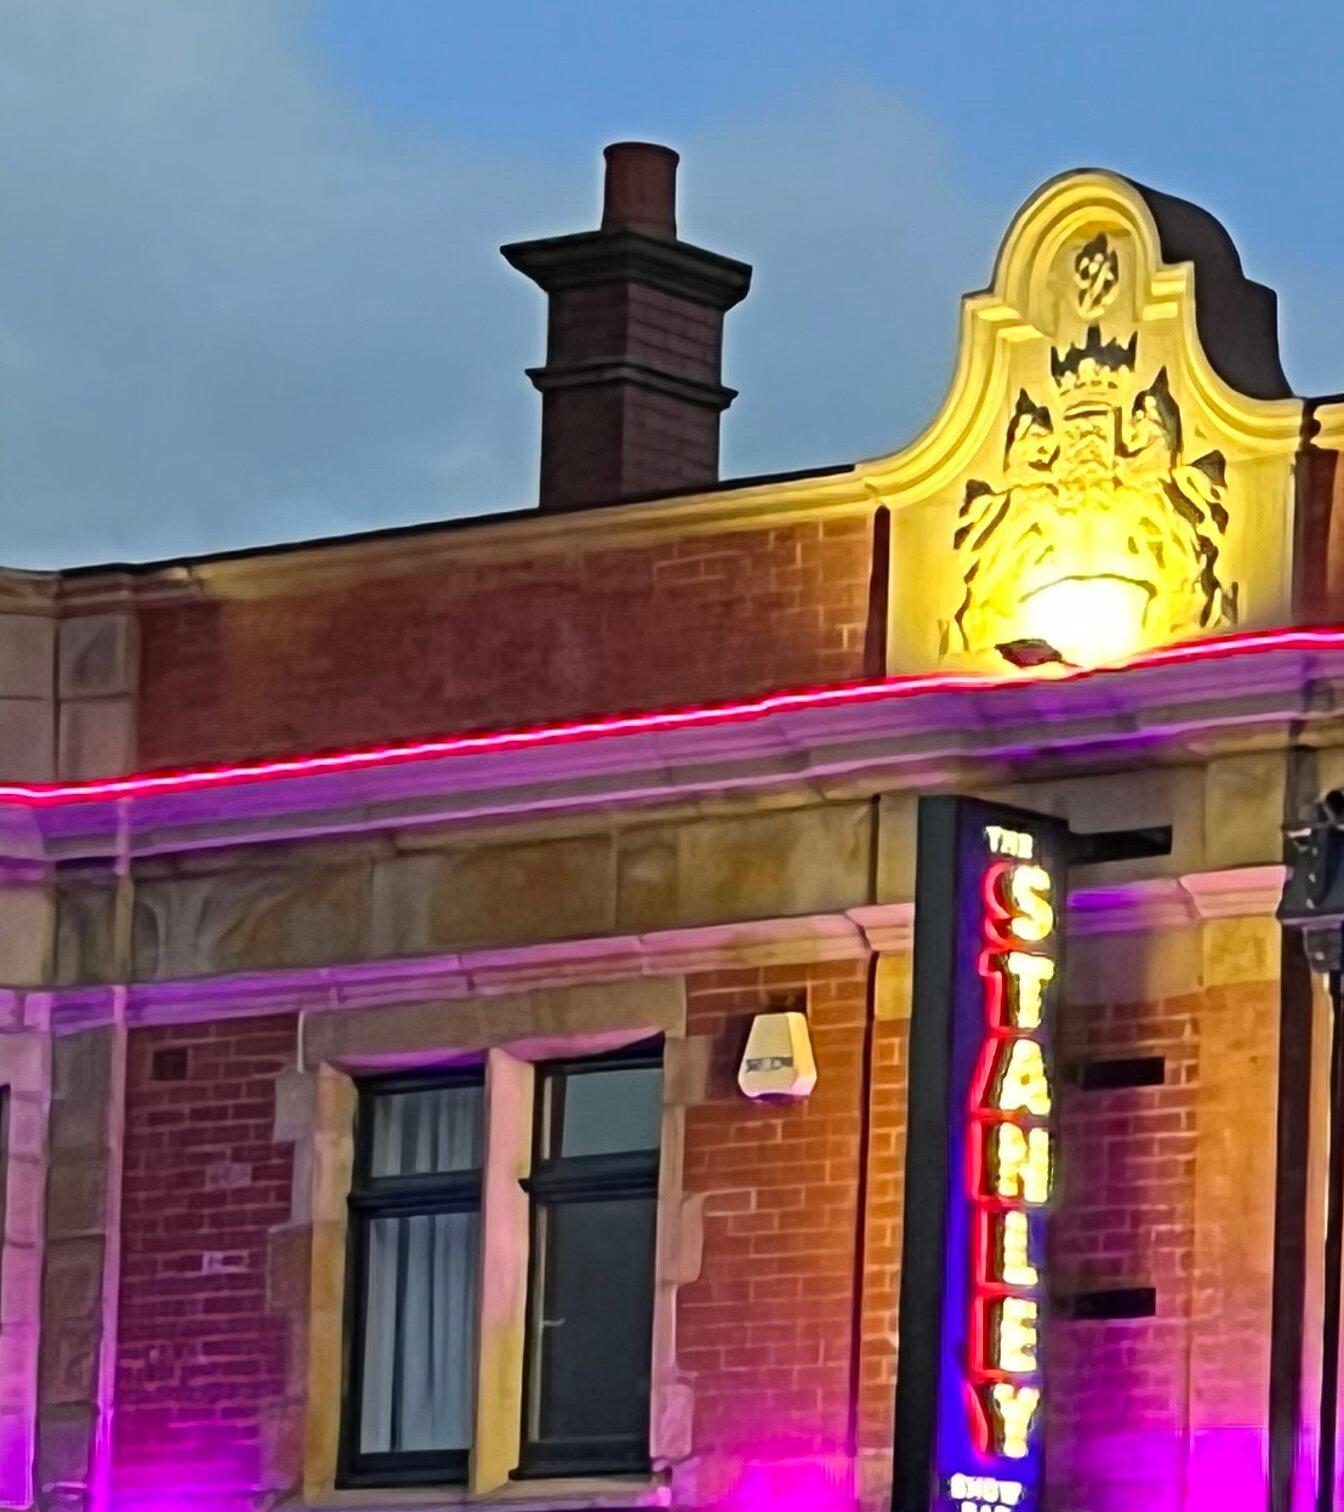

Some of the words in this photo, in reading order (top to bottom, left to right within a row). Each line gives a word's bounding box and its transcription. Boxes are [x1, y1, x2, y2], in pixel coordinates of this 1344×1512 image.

[985, 825, 1034, 860] THE
[990, 864, 1056, 1459] STANLEY
[949, 1472, 1023, 1506] SHOW
